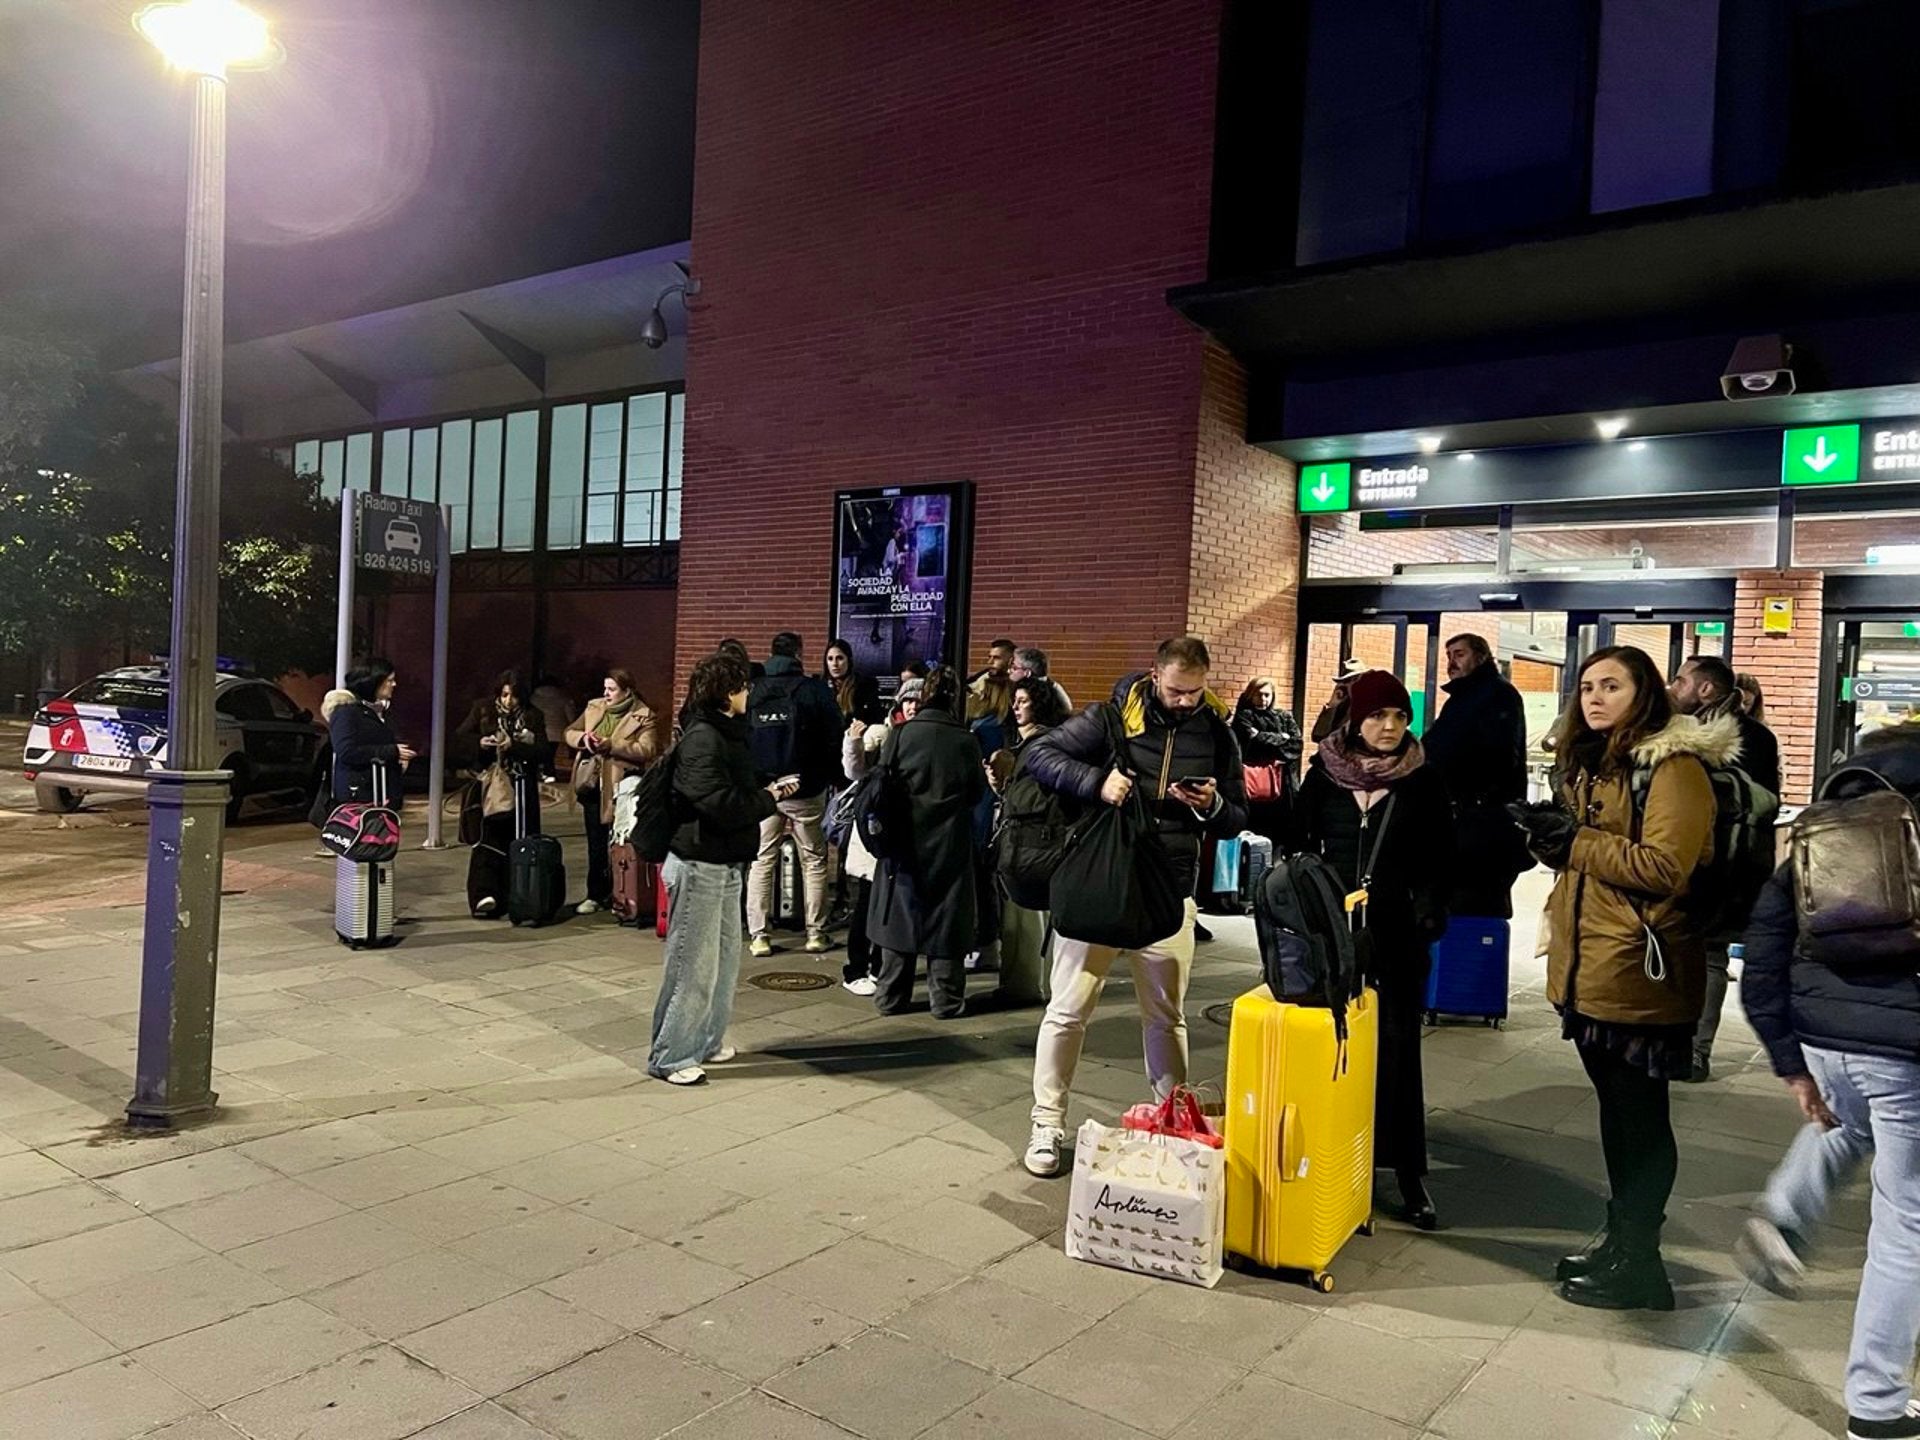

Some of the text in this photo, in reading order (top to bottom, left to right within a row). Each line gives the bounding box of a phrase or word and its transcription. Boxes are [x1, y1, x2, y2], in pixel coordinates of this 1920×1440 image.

[1873, 430, 1920, 452] Ent
[1359, 464, 1429, 487] Entrada
[364, 494, 423, 517] Radio Taxi
[363, 552, 432, 575] 926 424 519
[879, 567, 893, 577] LA
[848, 576, 893, 587] SOCIEDAD
[857, 584, 910, 596] AVANZA Y LA
[890, 591, 944, 603] PUBLICIDAD
[890, 601, 933, 612] CON ELLA
